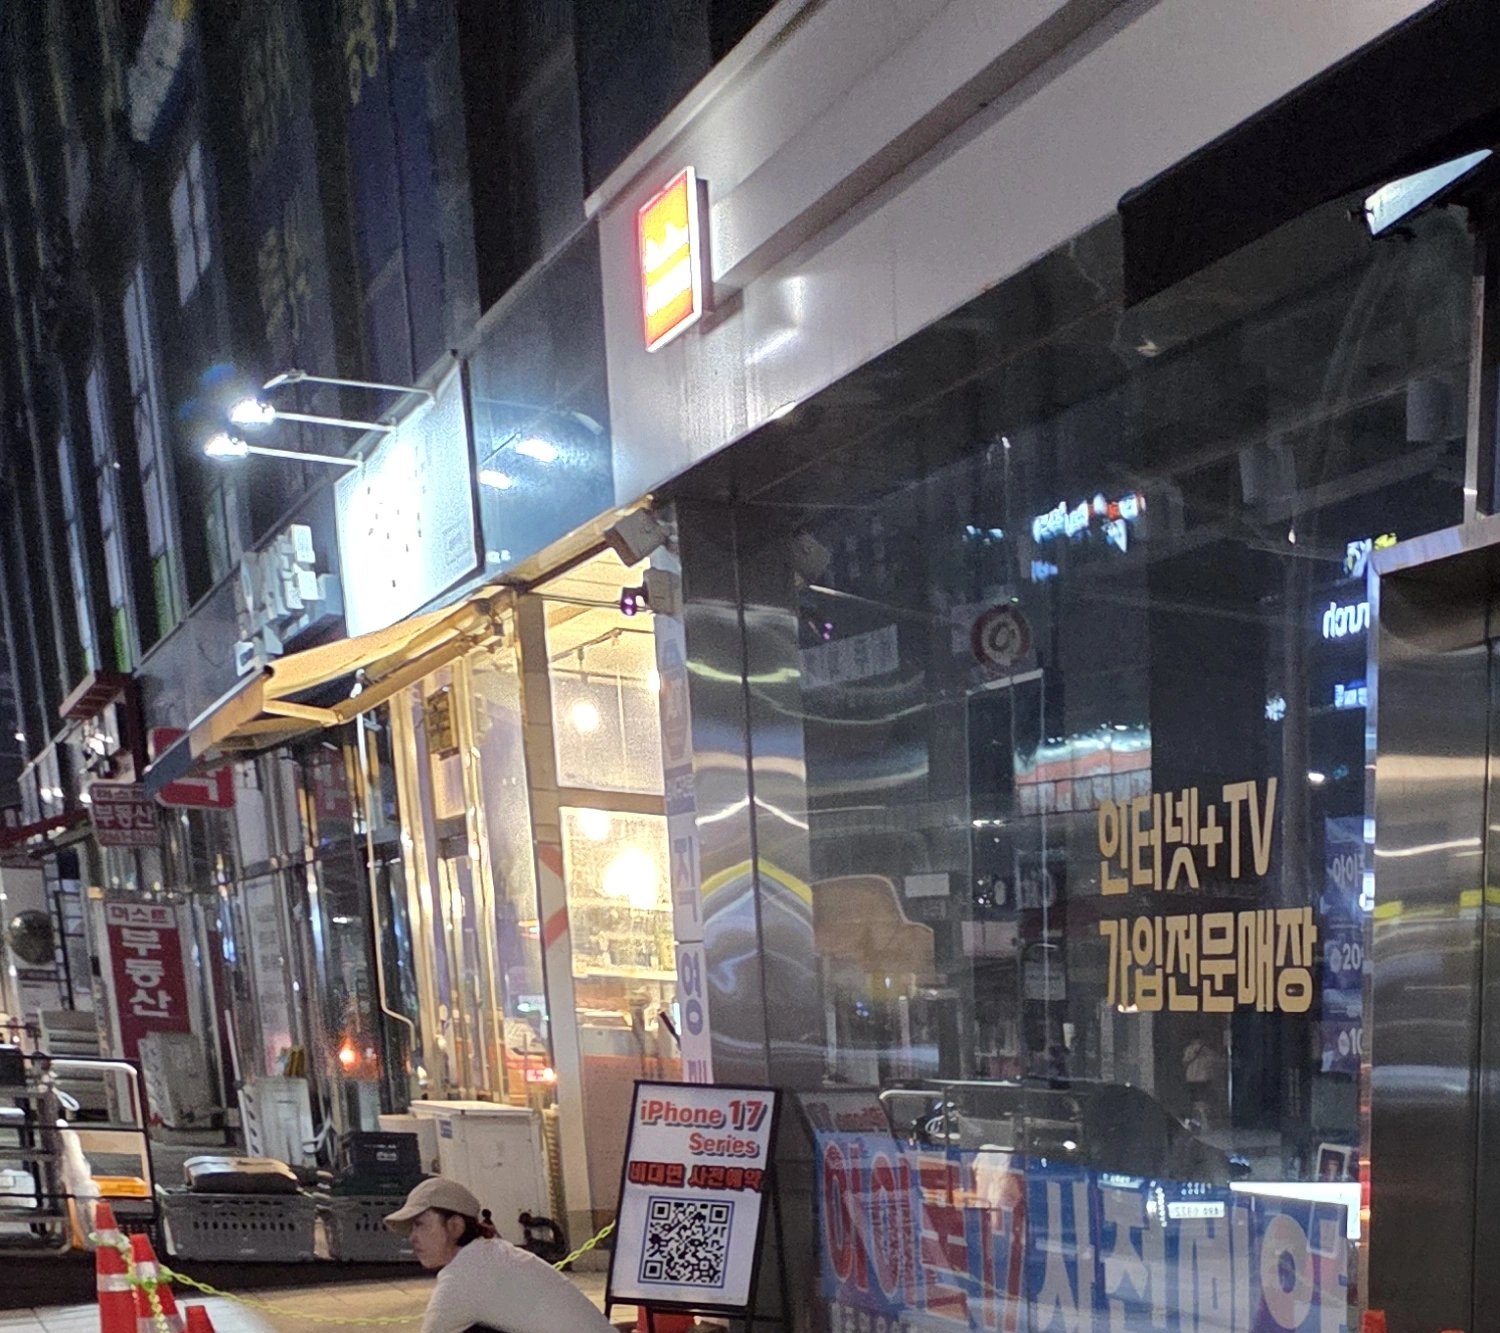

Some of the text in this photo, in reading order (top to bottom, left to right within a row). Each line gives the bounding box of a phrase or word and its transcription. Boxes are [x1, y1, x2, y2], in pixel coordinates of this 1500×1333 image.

[1098, 777, 1278, 896] 인터넷+TV
[121, 926, 182, 1029] 부동산
[1099, 907, 1318, 1013] 가입전문매장
[640, 1099, 768, 1132] iPhone 17
[689, 1132, 760, 1159] Series
[628, 1161, 766, 1193] 비대면 사전예약
